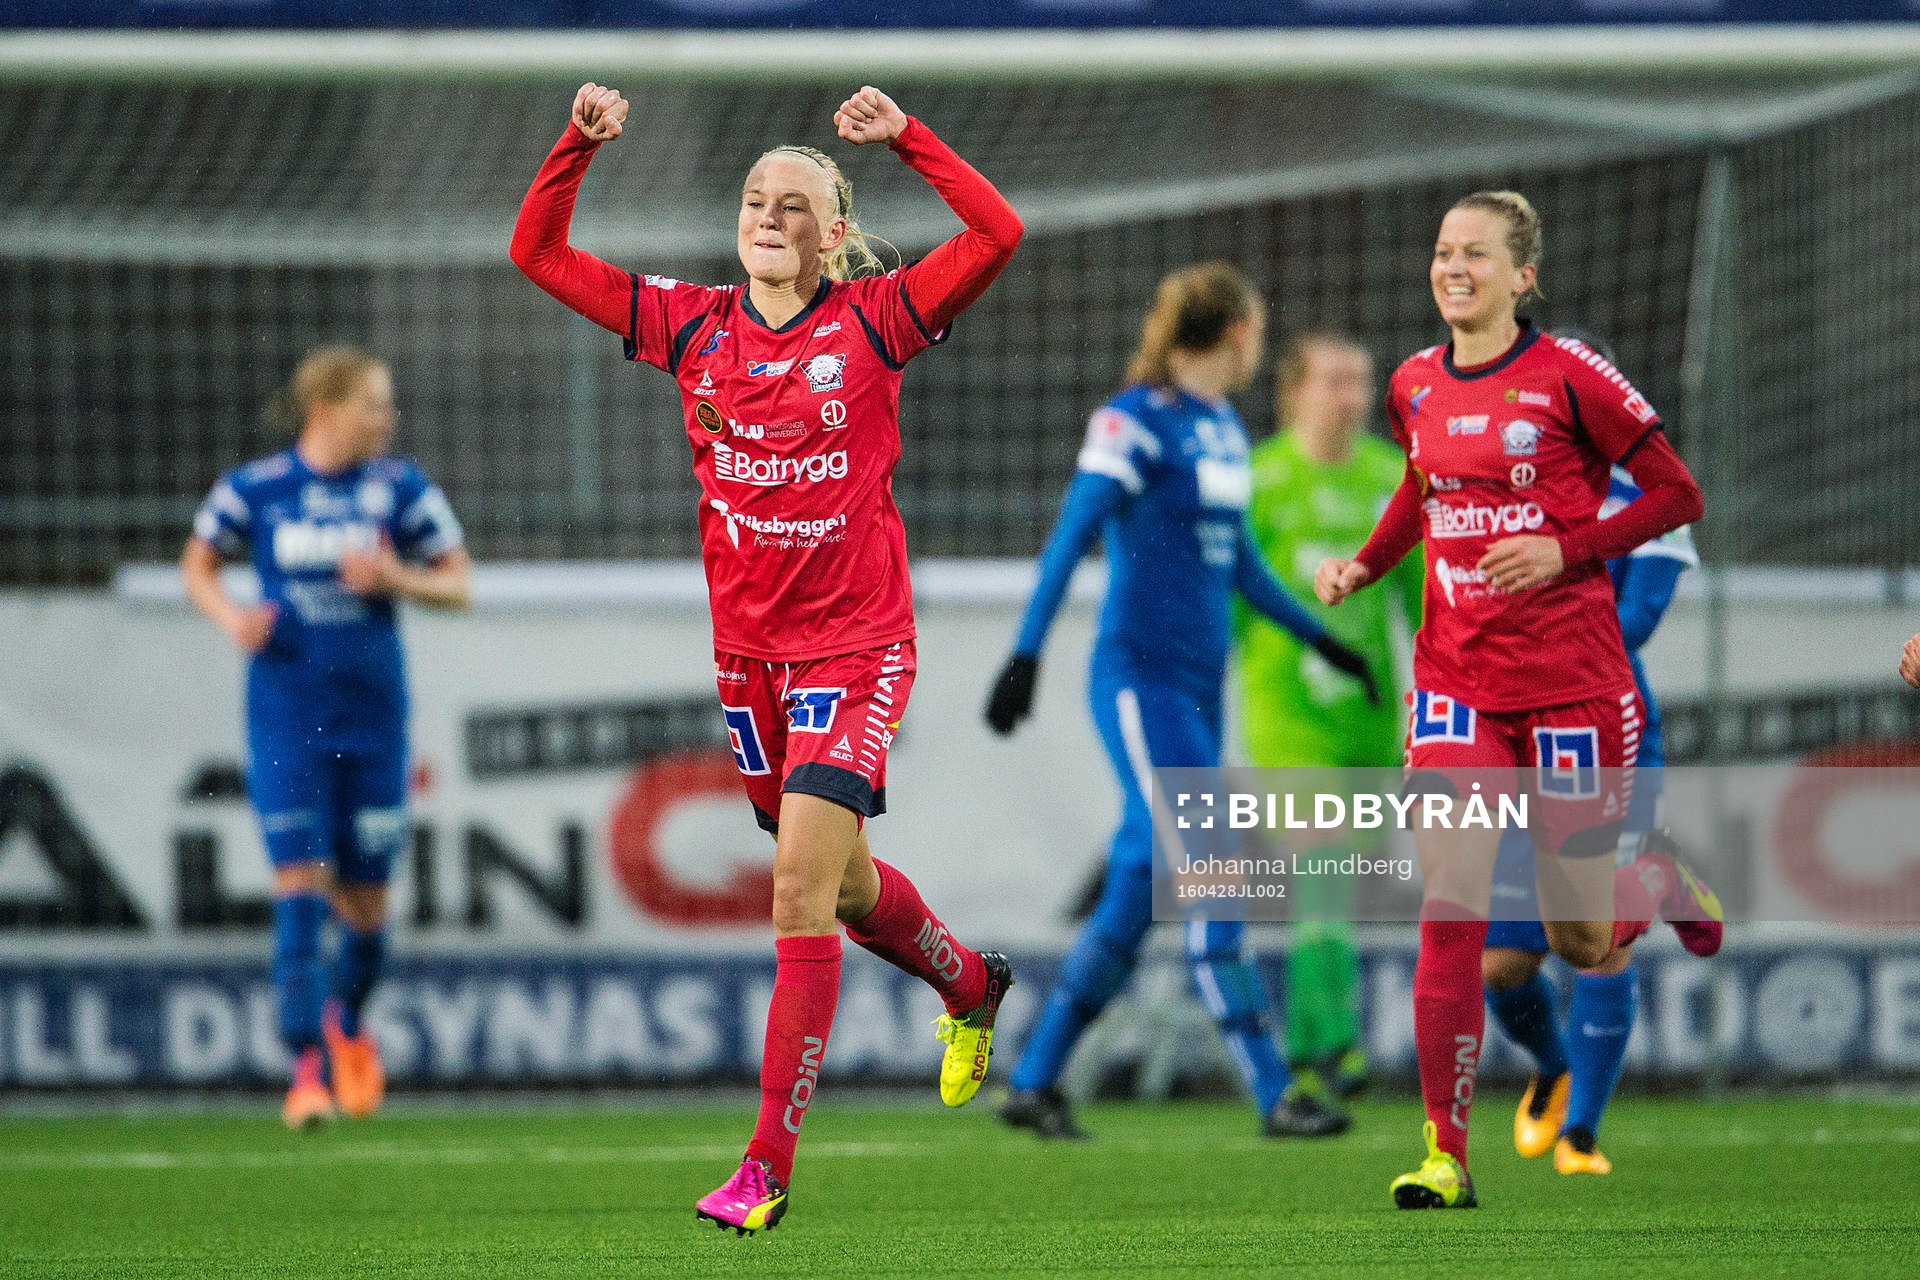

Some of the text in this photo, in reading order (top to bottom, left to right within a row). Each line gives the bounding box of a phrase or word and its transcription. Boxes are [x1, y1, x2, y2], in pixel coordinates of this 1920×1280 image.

[766, 428, 809, 439] UNIVERSITET
[734, 449, 849, 483] Botrygg
[829, 750, 855, 763] SELECT
